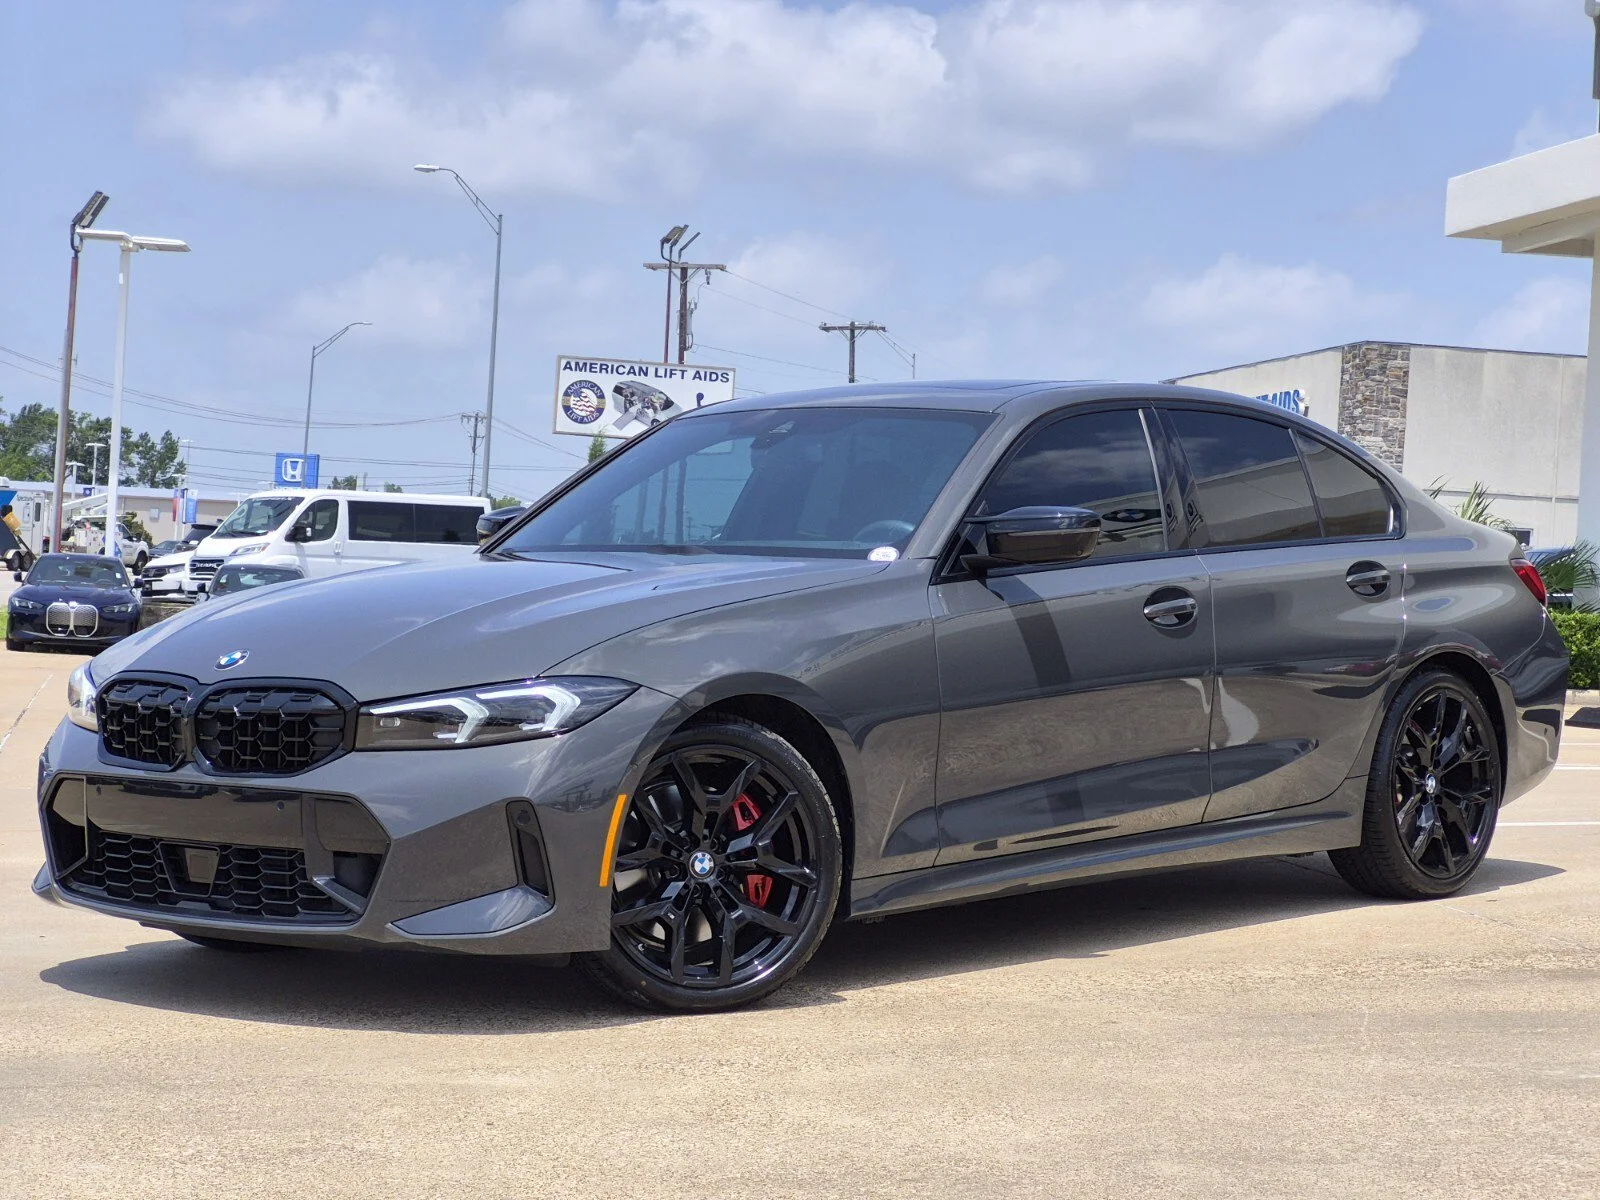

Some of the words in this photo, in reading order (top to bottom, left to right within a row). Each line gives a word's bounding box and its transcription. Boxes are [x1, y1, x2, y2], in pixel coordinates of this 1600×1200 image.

[563, 360, 649, 378] AMERICAN
[654, 367, 688, 380] LIFT
[692, 370, 730, 383] AIDS
[567, 381, 603, 396] AMERICAN
[567, 410, 583, 422] LIFT
[583, 410, 600, 423] AIDS
